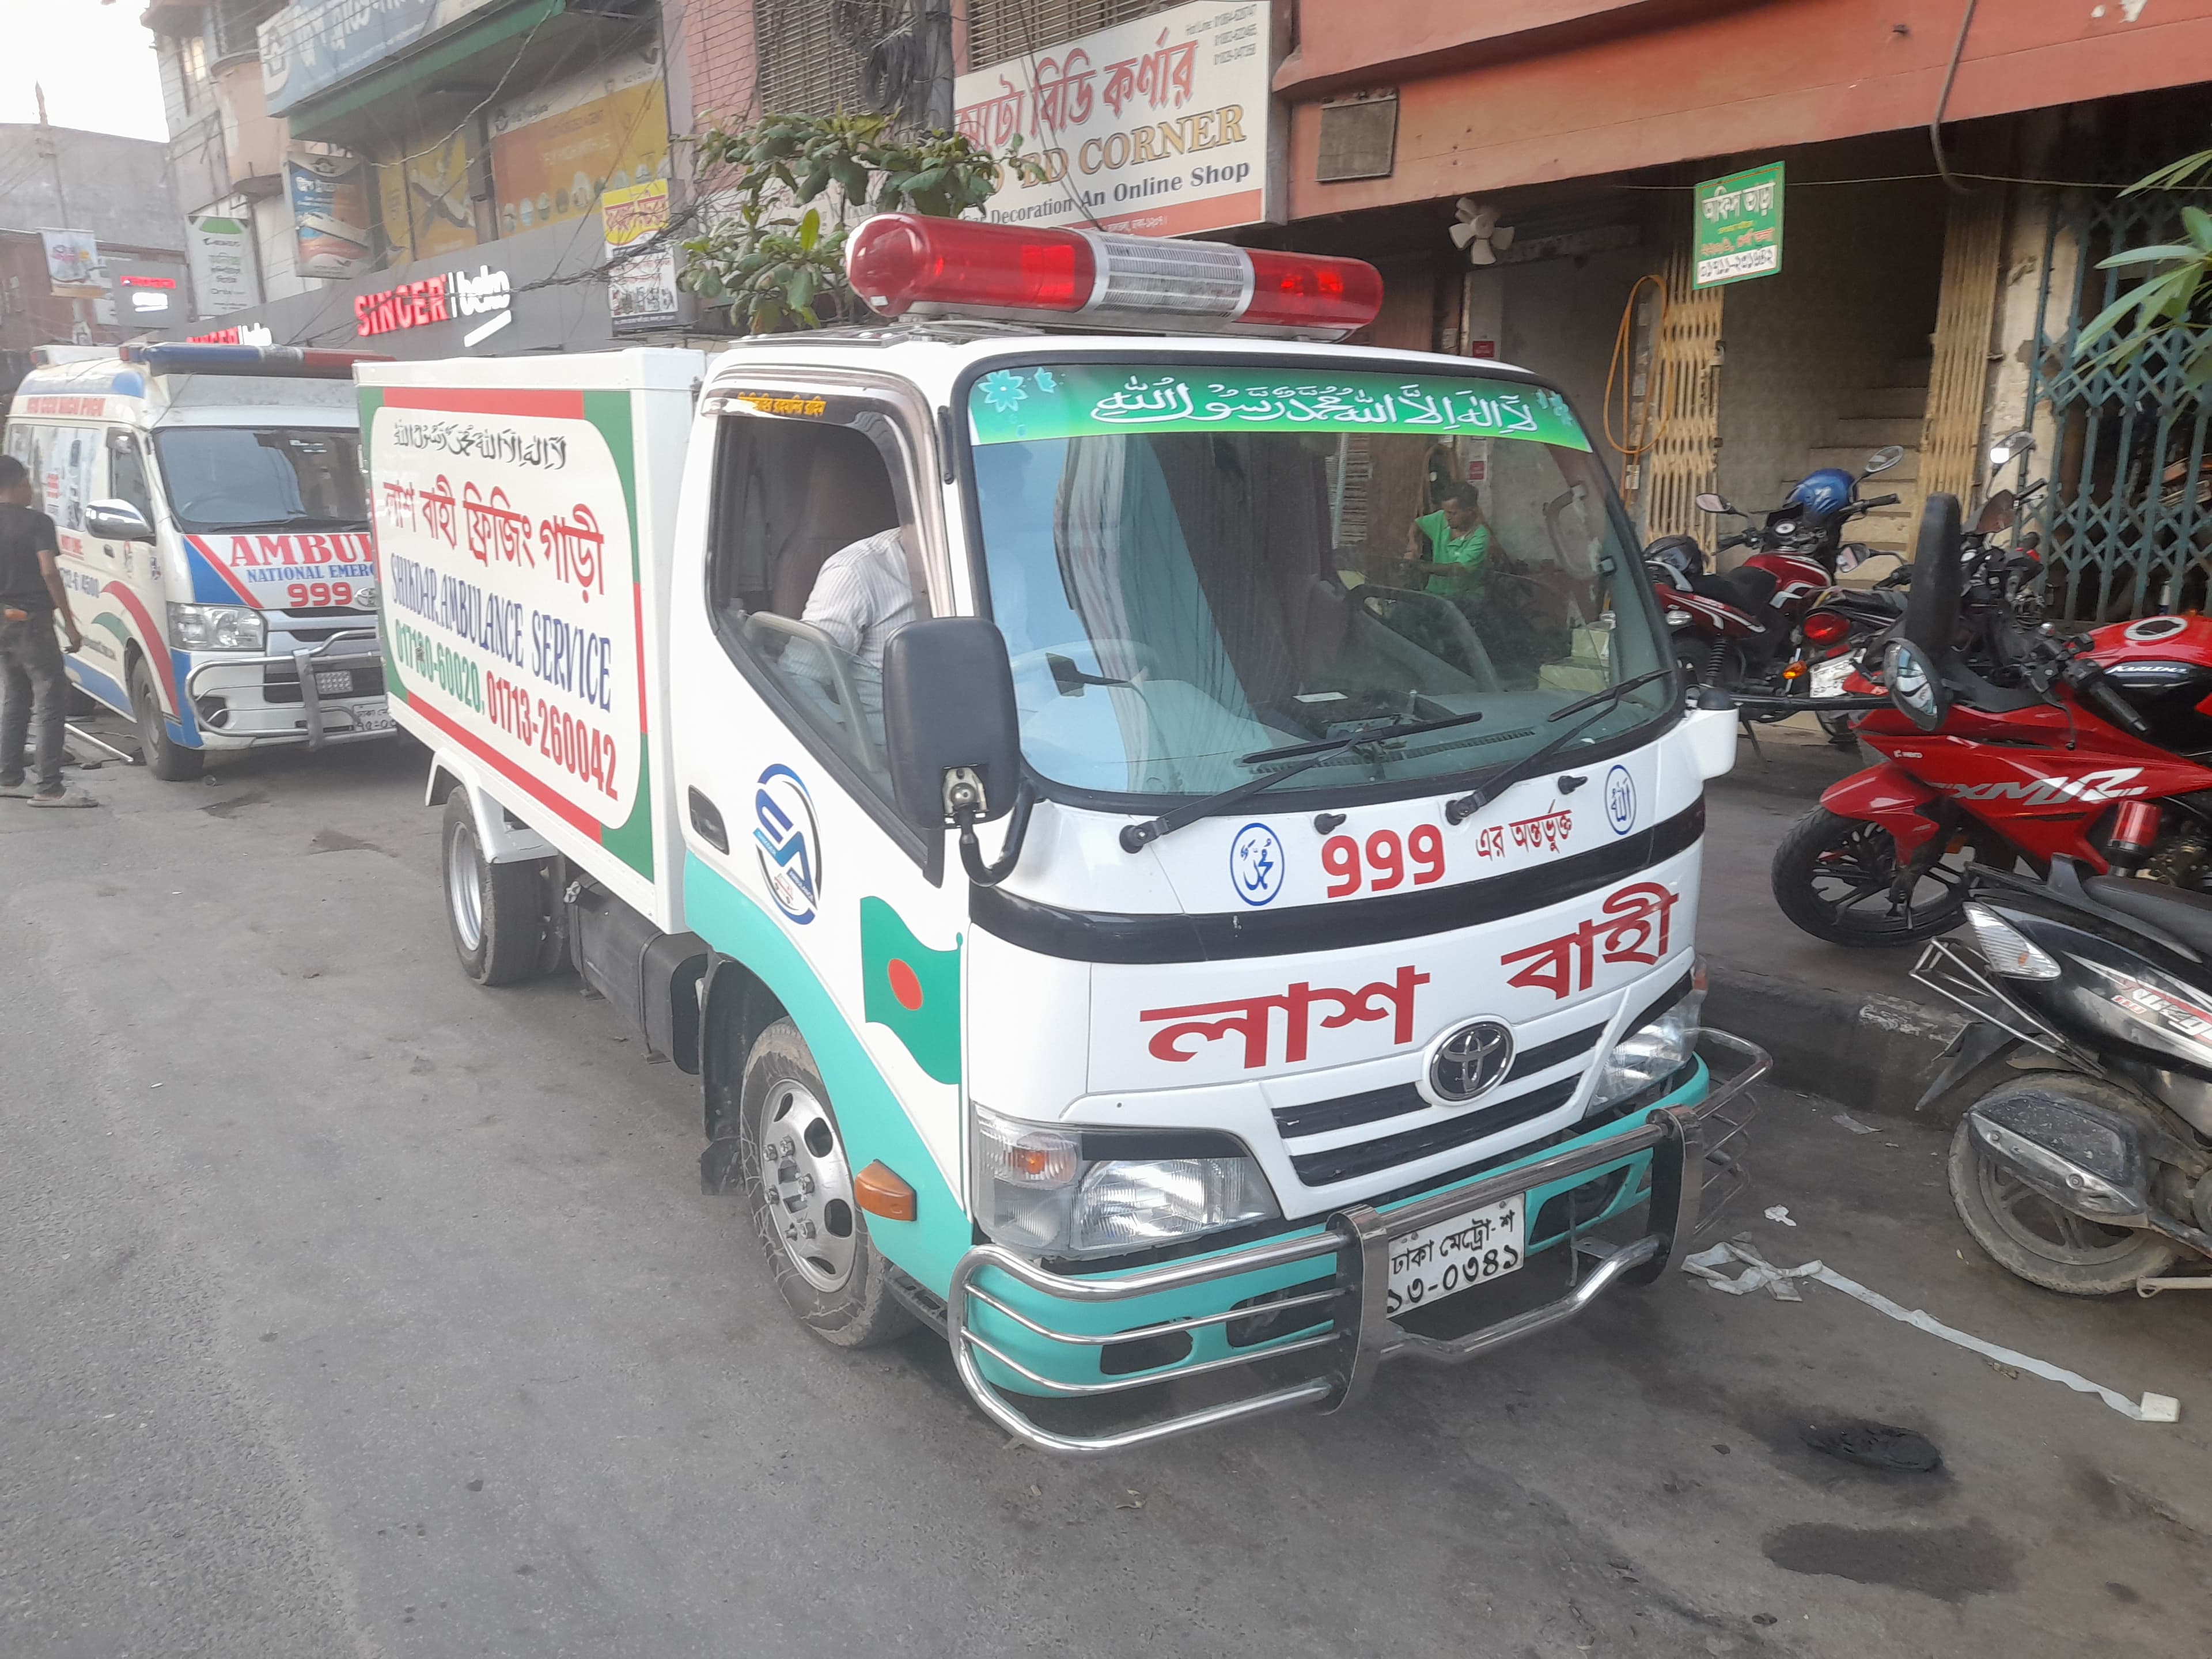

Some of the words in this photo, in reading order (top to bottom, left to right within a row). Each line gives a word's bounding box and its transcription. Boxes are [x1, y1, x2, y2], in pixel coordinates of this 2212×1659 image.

[1029, 47, 1097, 138] বিডি
[1079, 104, 1247, 175] CORNER
[990, 198, 1073, 224] Decoration
[1081, 190, 1105, 208] An
[1113, 169, 1182, 202] Online
[1191, 158, 1251, 188] Shop
[354, 274, 449, 337] SINGER
[246, 566, 325, 583] NATIONAL
[419, 474, 457, 550] বাহী
[539, 503, 604, 604] গাড়ী
[287, 581, 353, 608] 999
[440, 573, 524, 669] AMBULANCE
[531, 609, 612, 714] SERVICE
[486, 670, 619, 802] 01713-260042
[1321, 824, 1446, 899] 999
[1475, 825, 1505, 861] এর
[1139, 965, 1431, 1070] লাশ
[1501, 881, 1680, 1001] বাহী
[1387, 1244, 1518, 1314] ১৩-০৩৪১
[1391, 1239, 1434, 1275] ঢাকা
